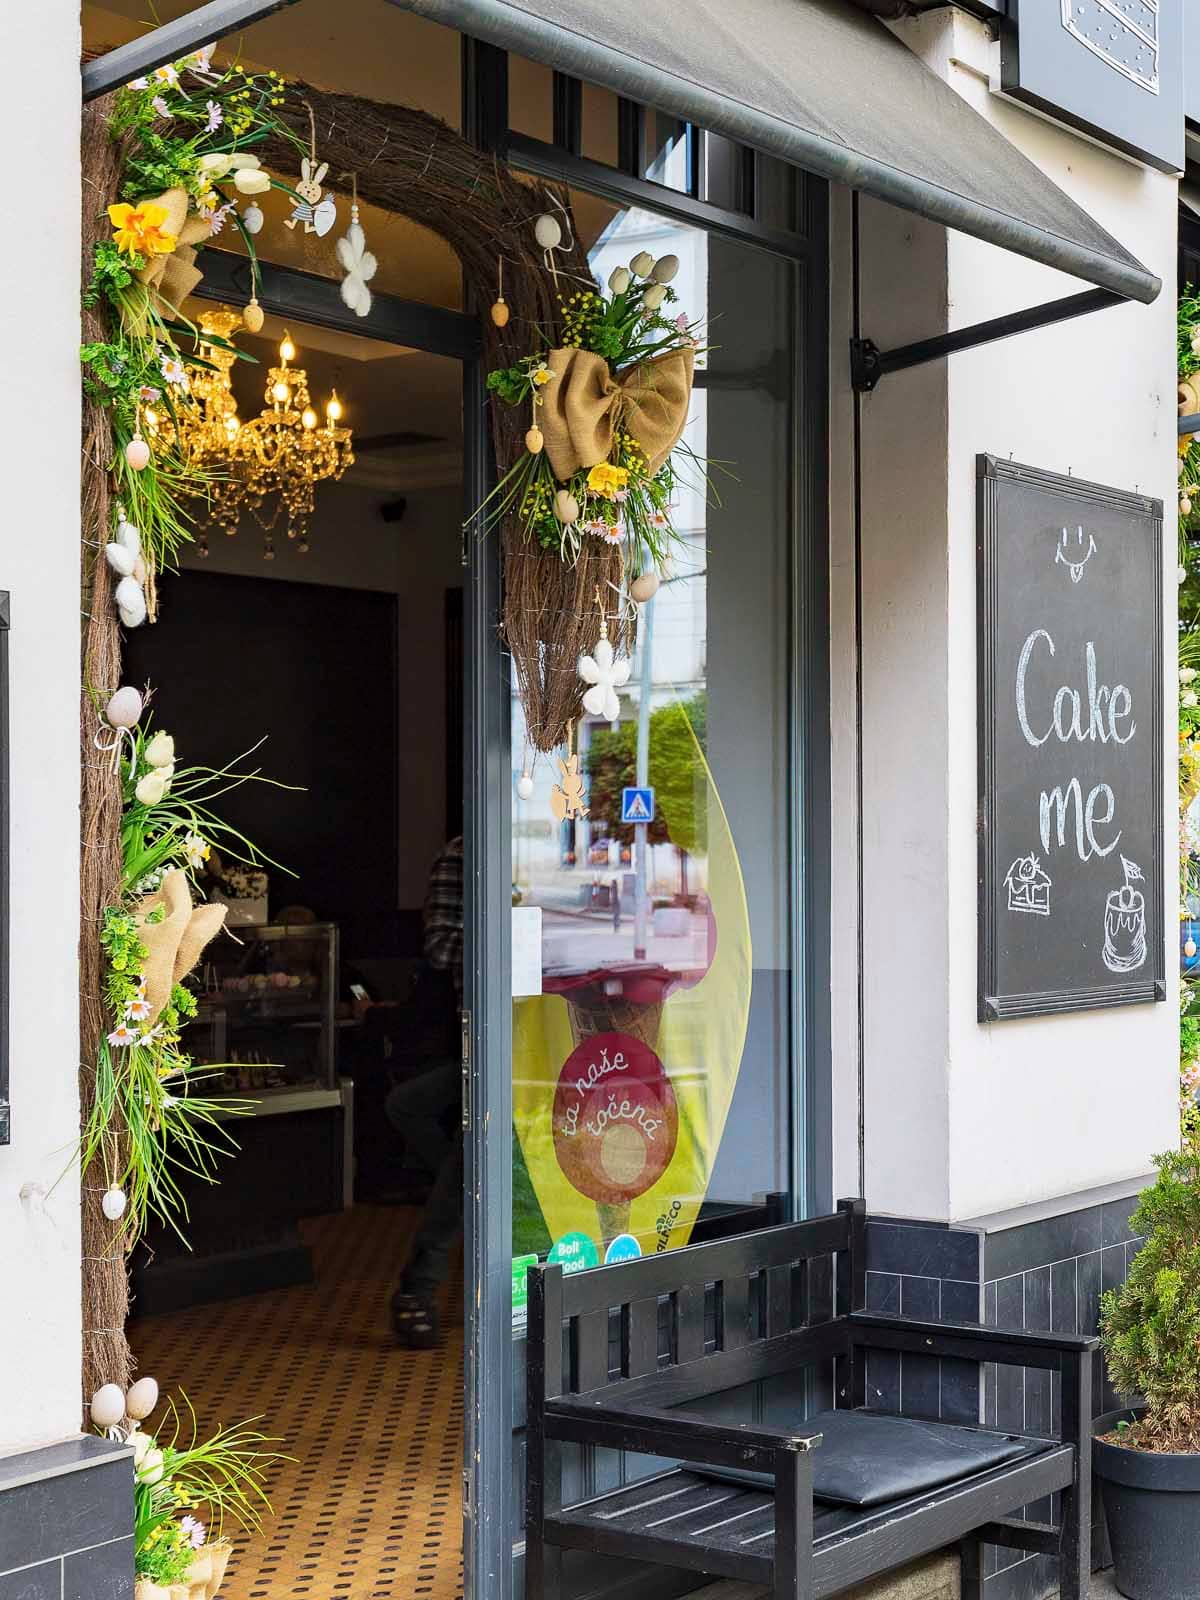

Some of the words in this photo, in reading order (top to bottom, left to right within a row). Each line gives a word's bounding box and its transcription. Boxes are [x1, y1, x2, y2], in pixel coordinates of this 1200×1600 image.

[1016, 628, 1136, 747] Cake
[1040, 777, 1122, 863] me
[562, 1102, 580, 1137] ta
[575, 1047, 629, 1098] naše
[586, 1093, 663, 1141] točená
